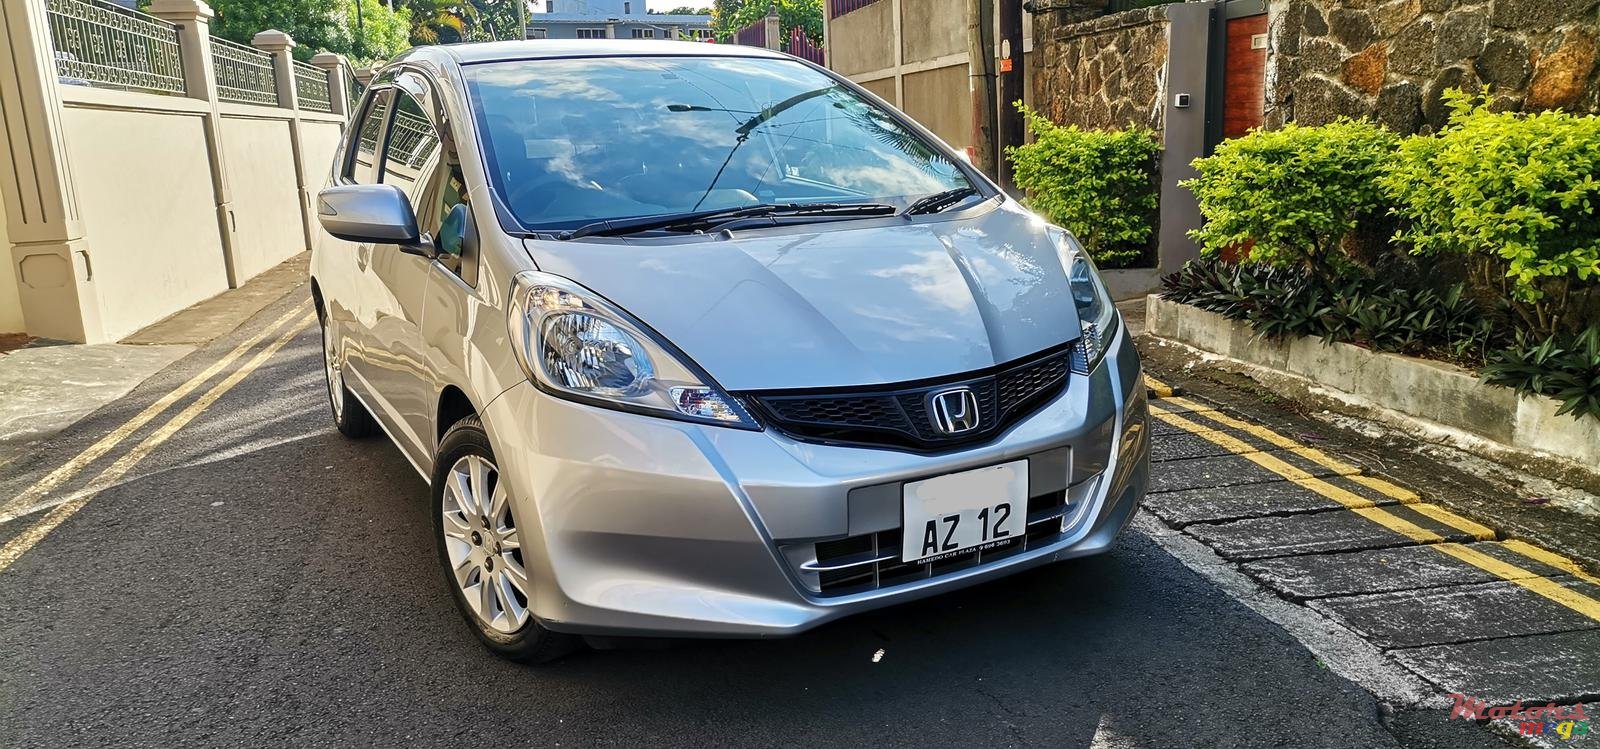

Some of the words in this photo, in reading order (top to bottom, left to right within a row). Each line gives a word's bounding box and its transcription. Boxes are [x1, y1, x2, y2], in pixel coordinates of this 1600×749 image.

[921, 514, 960, 556] AZ
[978, 503, 1011, 541] 12
[944, 551, 957, 559] CAR
